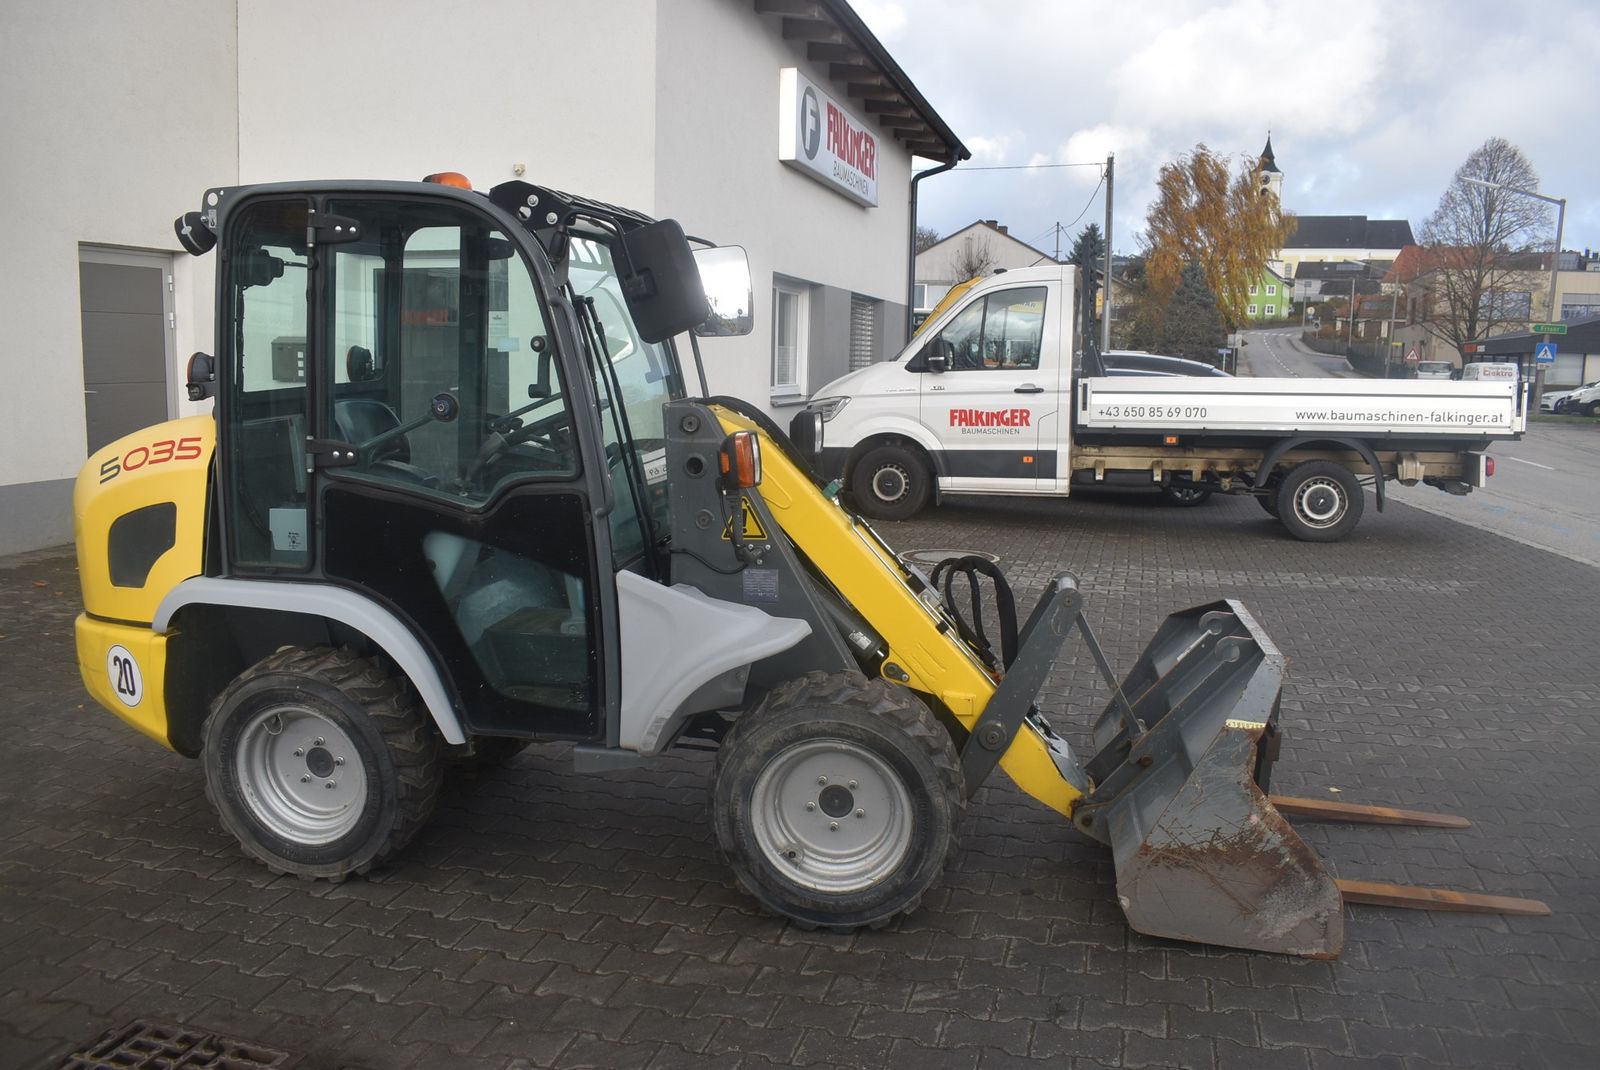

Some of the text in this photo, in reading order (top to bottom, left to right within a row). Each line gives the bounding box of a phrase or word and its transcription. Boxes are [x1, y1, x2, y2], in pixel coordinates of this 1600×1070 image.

[826, 101, 875, 181] FALKINGER
[832, 160, 869, 196] BAUMASCHINEN
[949, 409, 1031, 427] FALKINGER
[1098, 406, 1207, 418] +43 650 85 69 070
[1295, 409, 1504, 426] www.baumaschinen-falkinger.at
[961, 427, 1020, 435] BAUMASCHINEN
[99, 437, 202, 485] 5035
[113, 655, 136, 697] 20
